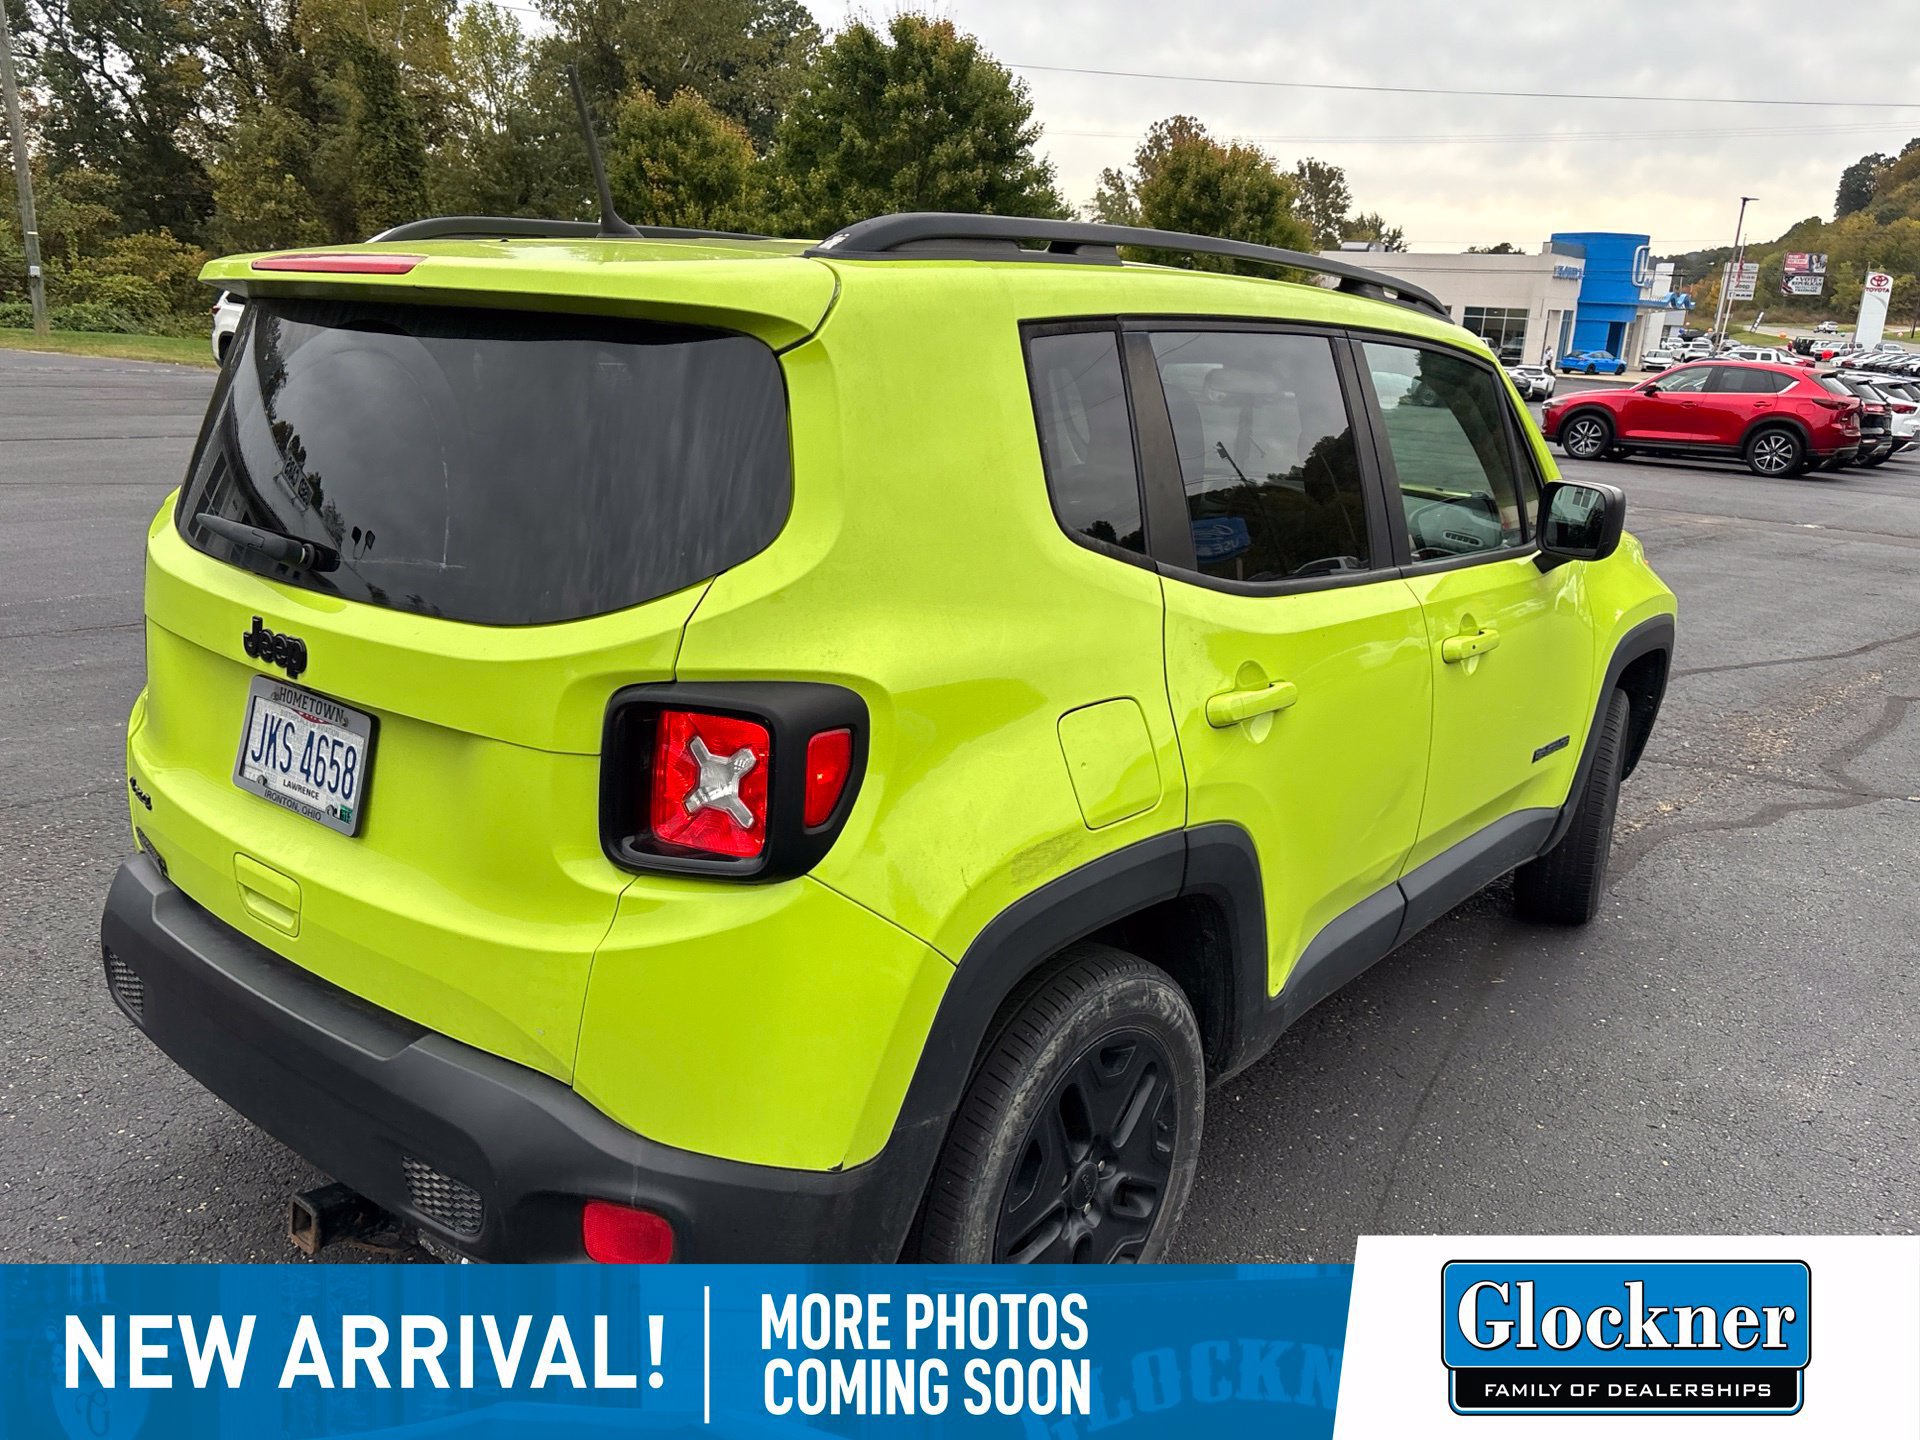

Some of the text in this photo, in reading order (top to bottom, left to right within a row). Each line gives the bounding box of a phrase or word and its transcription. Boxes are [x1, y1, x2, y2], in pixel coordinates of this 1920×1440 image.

[243, 616, 307, 679] Jeep
[279, 686, 345, 722] HOMETOWN
[251, 712, 357, 800] JKS 4658
[264, 789, 300, 812] IRONTON,
[302, 805, 322, 821] OHIO
[283, 779, 320, 800] LAWRENCE
